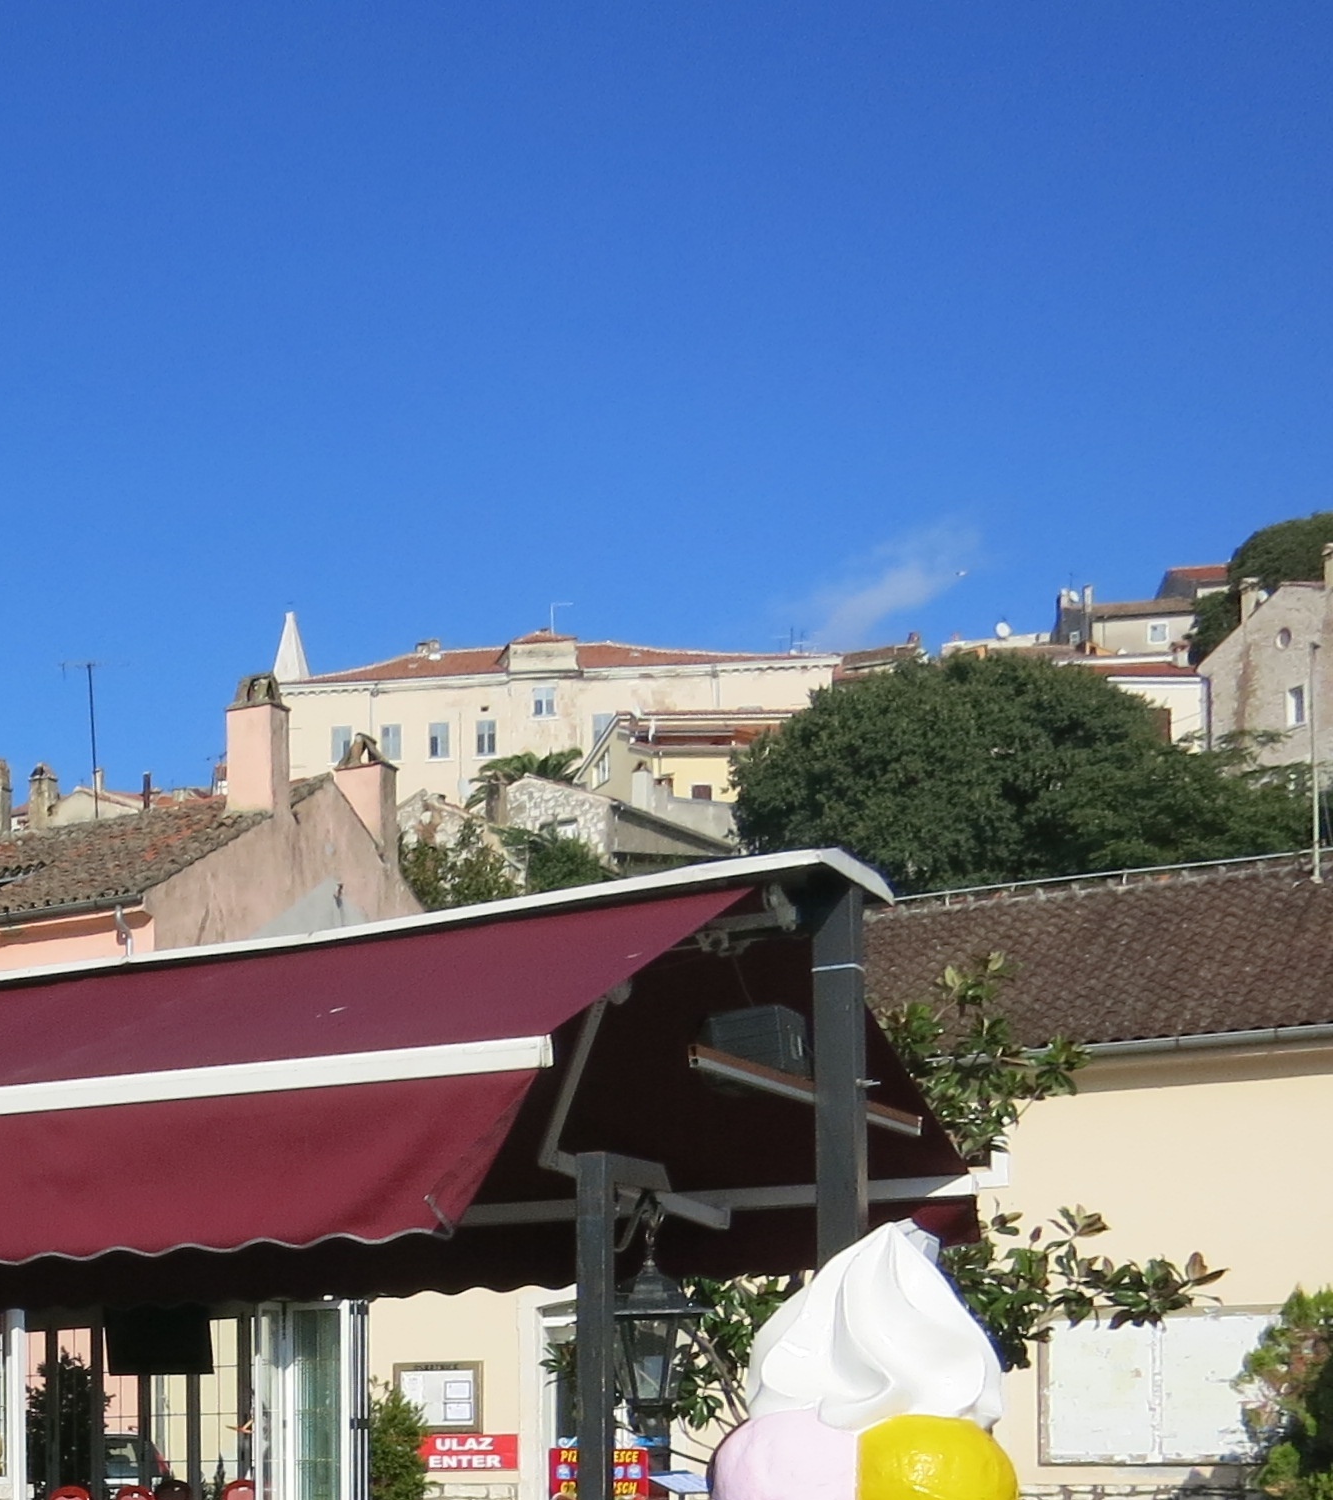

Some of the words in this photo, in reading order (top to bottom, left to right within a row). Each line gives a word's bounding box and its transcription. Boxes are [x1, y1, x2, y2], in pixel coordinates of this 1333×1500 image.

[435, 1438, 494, 1451] ULAZ
[428, 1455, 502, 1468] ENTER
[613, 1450, 640, 1463] ESCE
